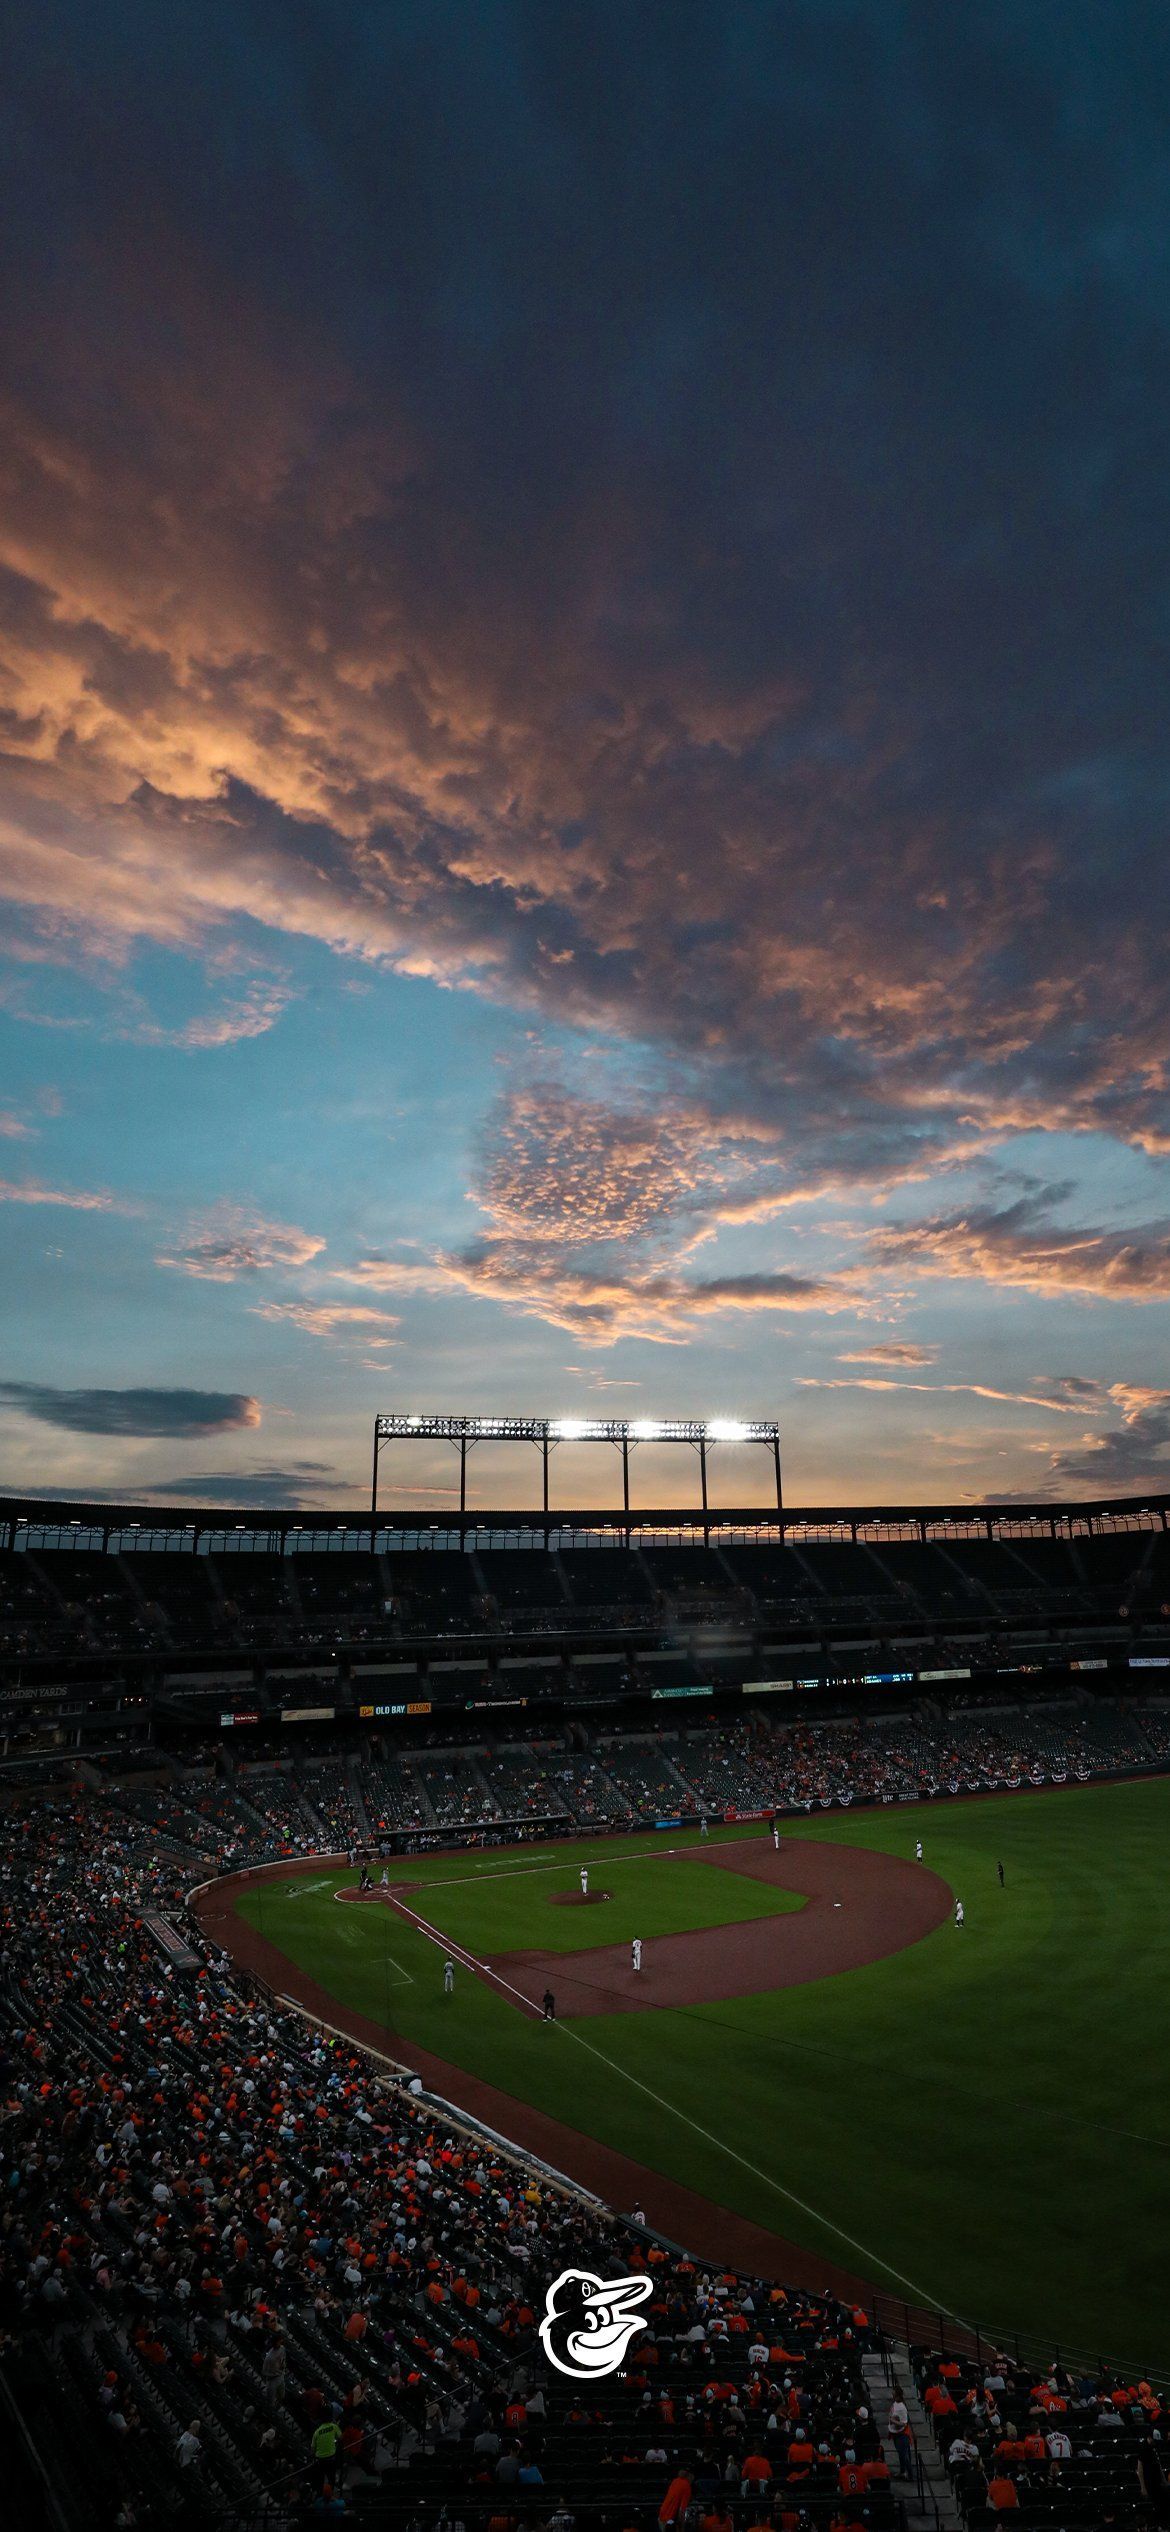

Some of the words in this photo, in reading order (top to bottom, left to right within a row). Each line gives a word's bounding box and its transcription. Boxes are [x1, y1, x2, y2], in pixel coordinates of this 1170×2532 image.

[39, 1687, 67, 1696] YARDS
[375, 1706, 390, 1715] OLD
[391, 1705, 405, 1714] BAY
[408, 1703, 430, 1713] SEASON
[1055, 2442, 1063, 2457] 7
[849, 2473, 857, 2490] 8
